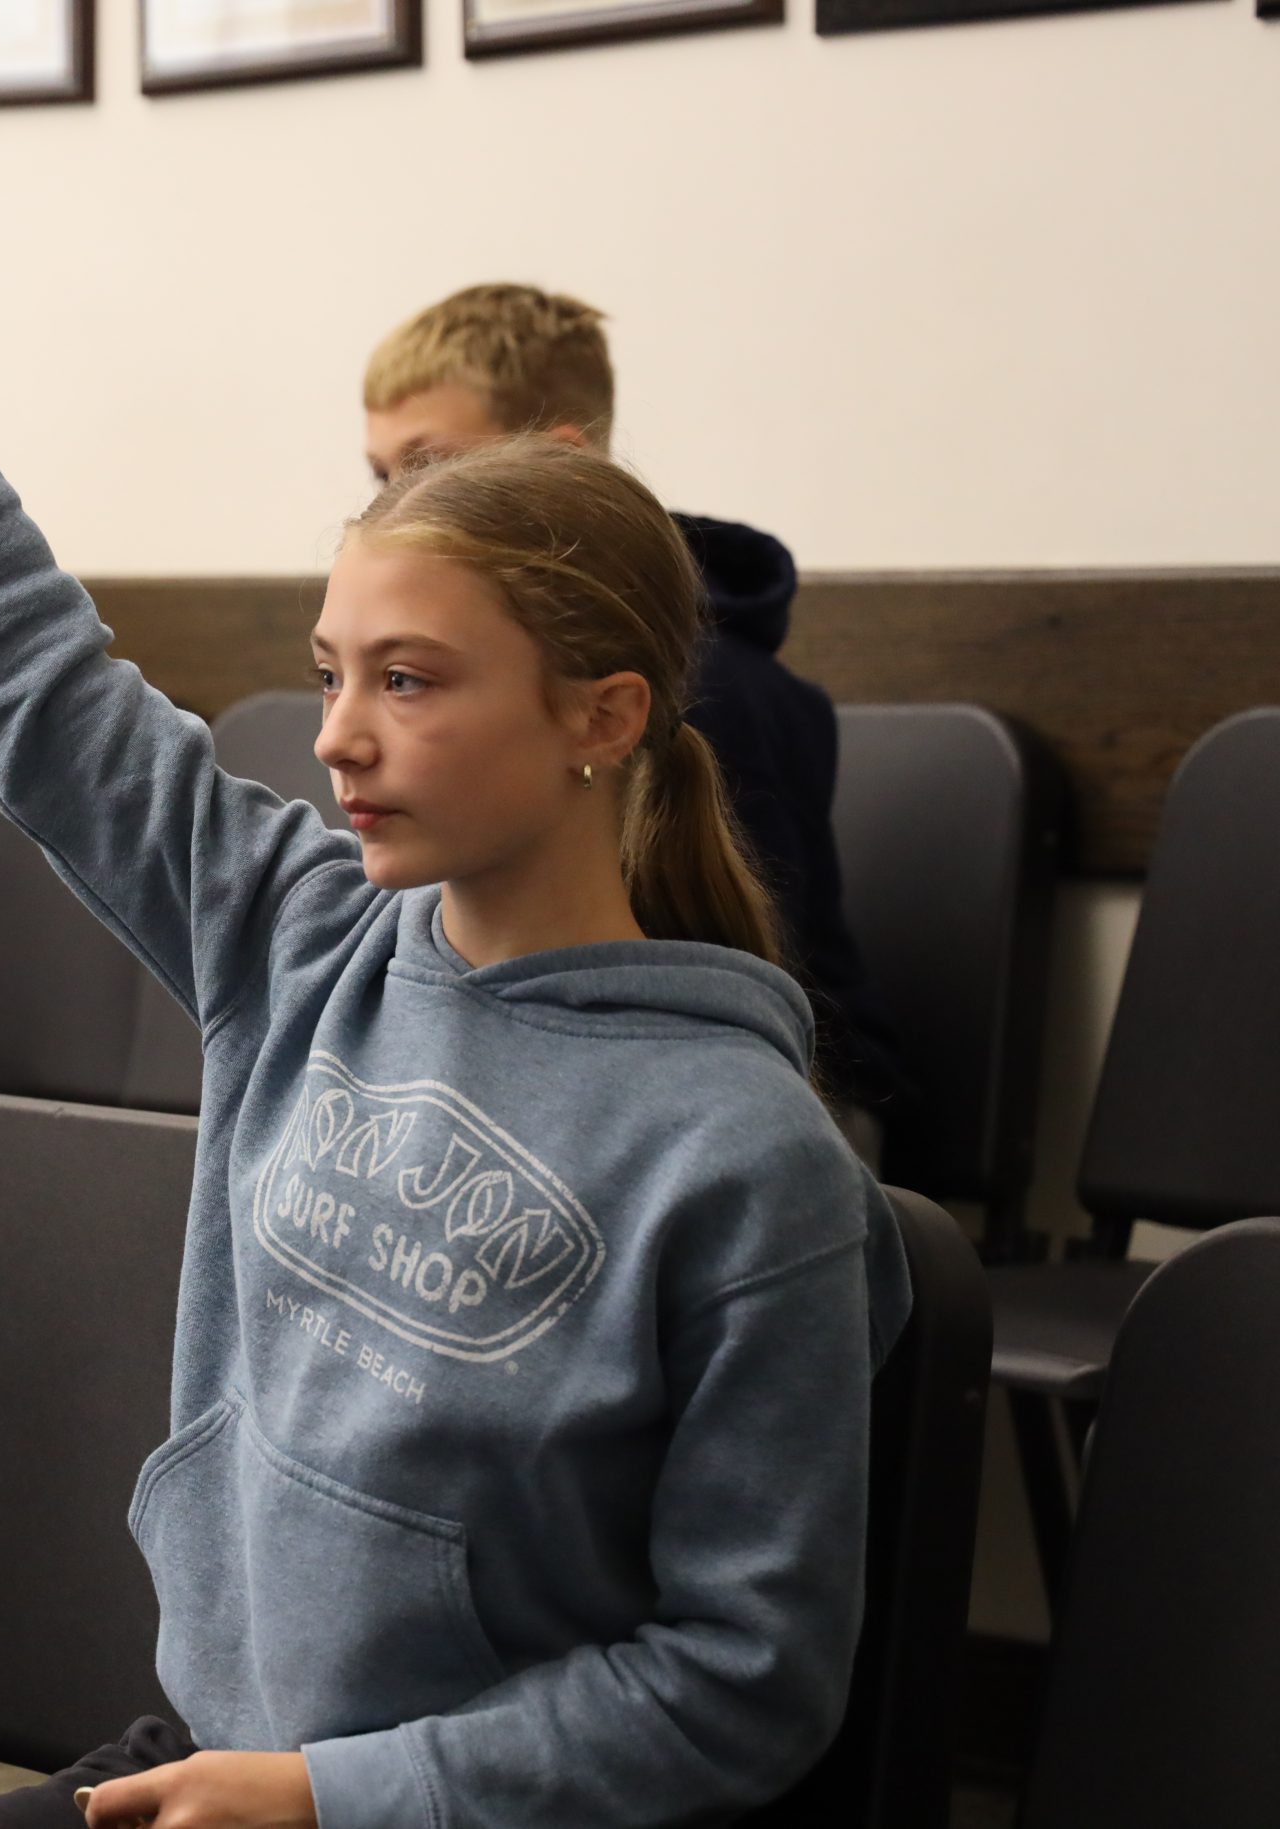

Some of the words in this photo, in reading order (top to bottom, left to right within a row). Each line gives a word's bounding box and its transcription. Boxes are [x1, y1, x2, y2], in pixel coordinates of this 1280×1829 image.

[277, 1173, 356, 1249] SURF
[368, 1223, 487, 1314] SHOP
[283, 1085, 417, 1179] RON
[398, 1133, 575, 1290] JON
[266, 1288, 352, 1355] MYRTLE
[357, 1343, 425, 1405] BEACH
